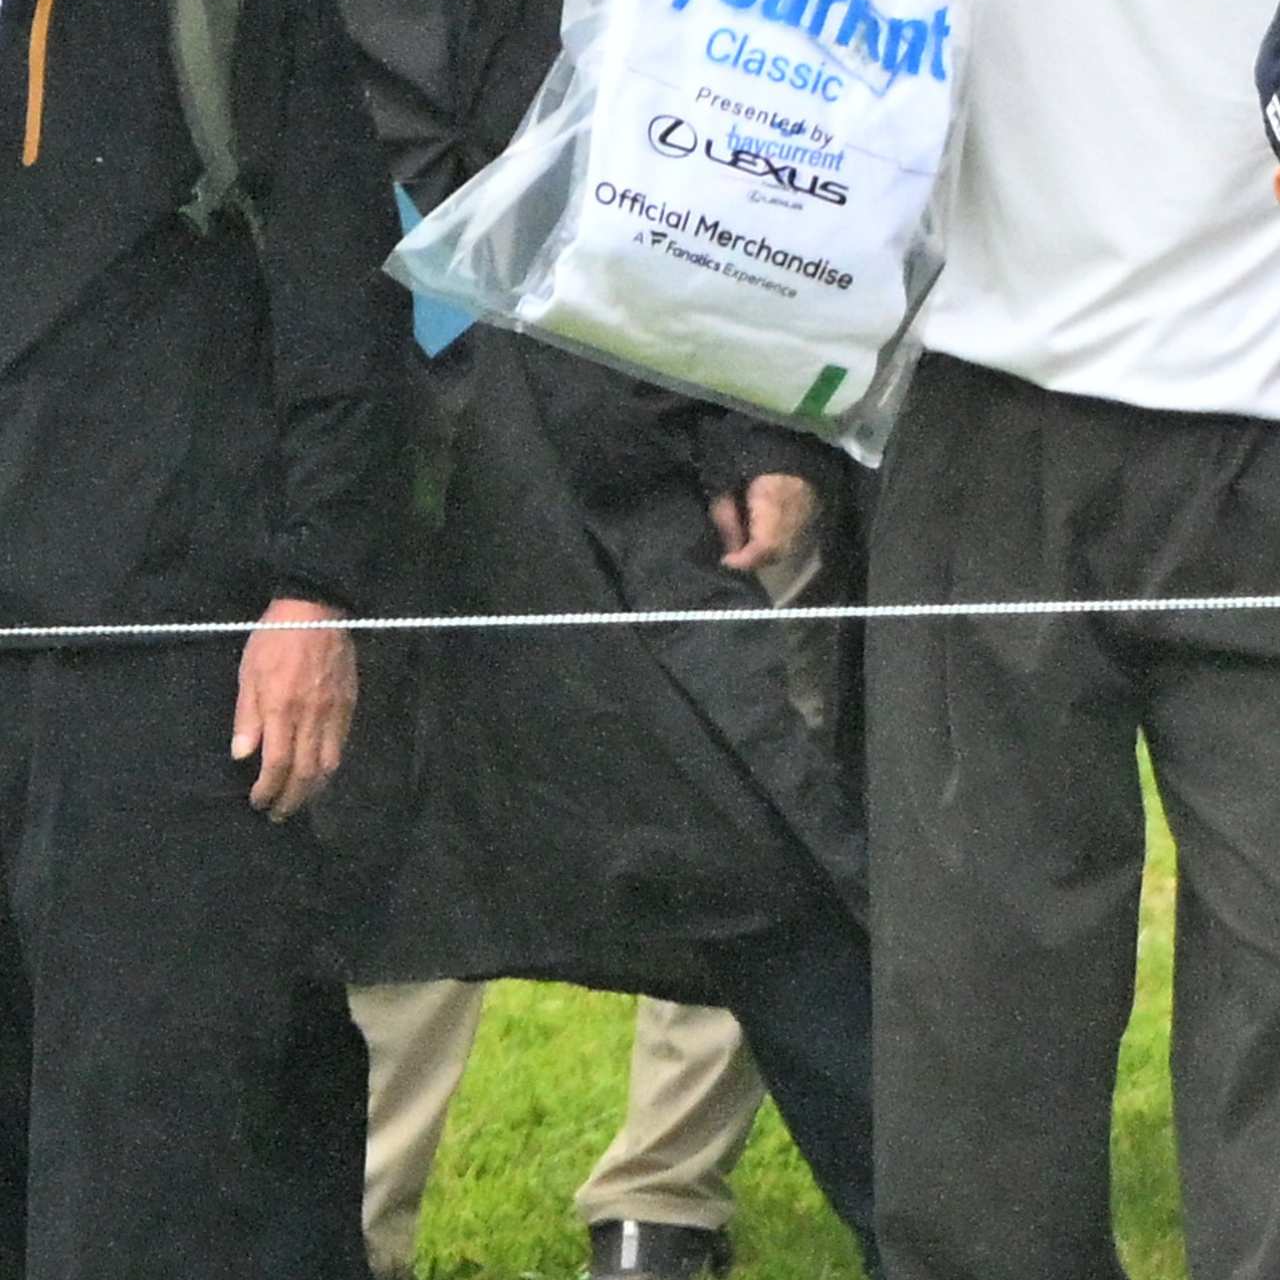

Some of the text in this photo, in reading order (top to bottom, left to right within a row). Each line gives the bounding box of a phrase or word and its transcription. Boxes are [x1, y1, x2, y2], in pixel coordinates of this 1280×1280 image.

[705, 27, 845, 103] Classic
[695, 86, 835, 150] Presented by
[726, 124, 846, 170] baycurrent
[704, 138, 849, 206] LEXUS
[594, 181, 854, 291] Official Merchandise
[632, 230, 645, 245] A
[664, 239, 722, 273] Fanatics
[721, 261, 798, 300] Experience
